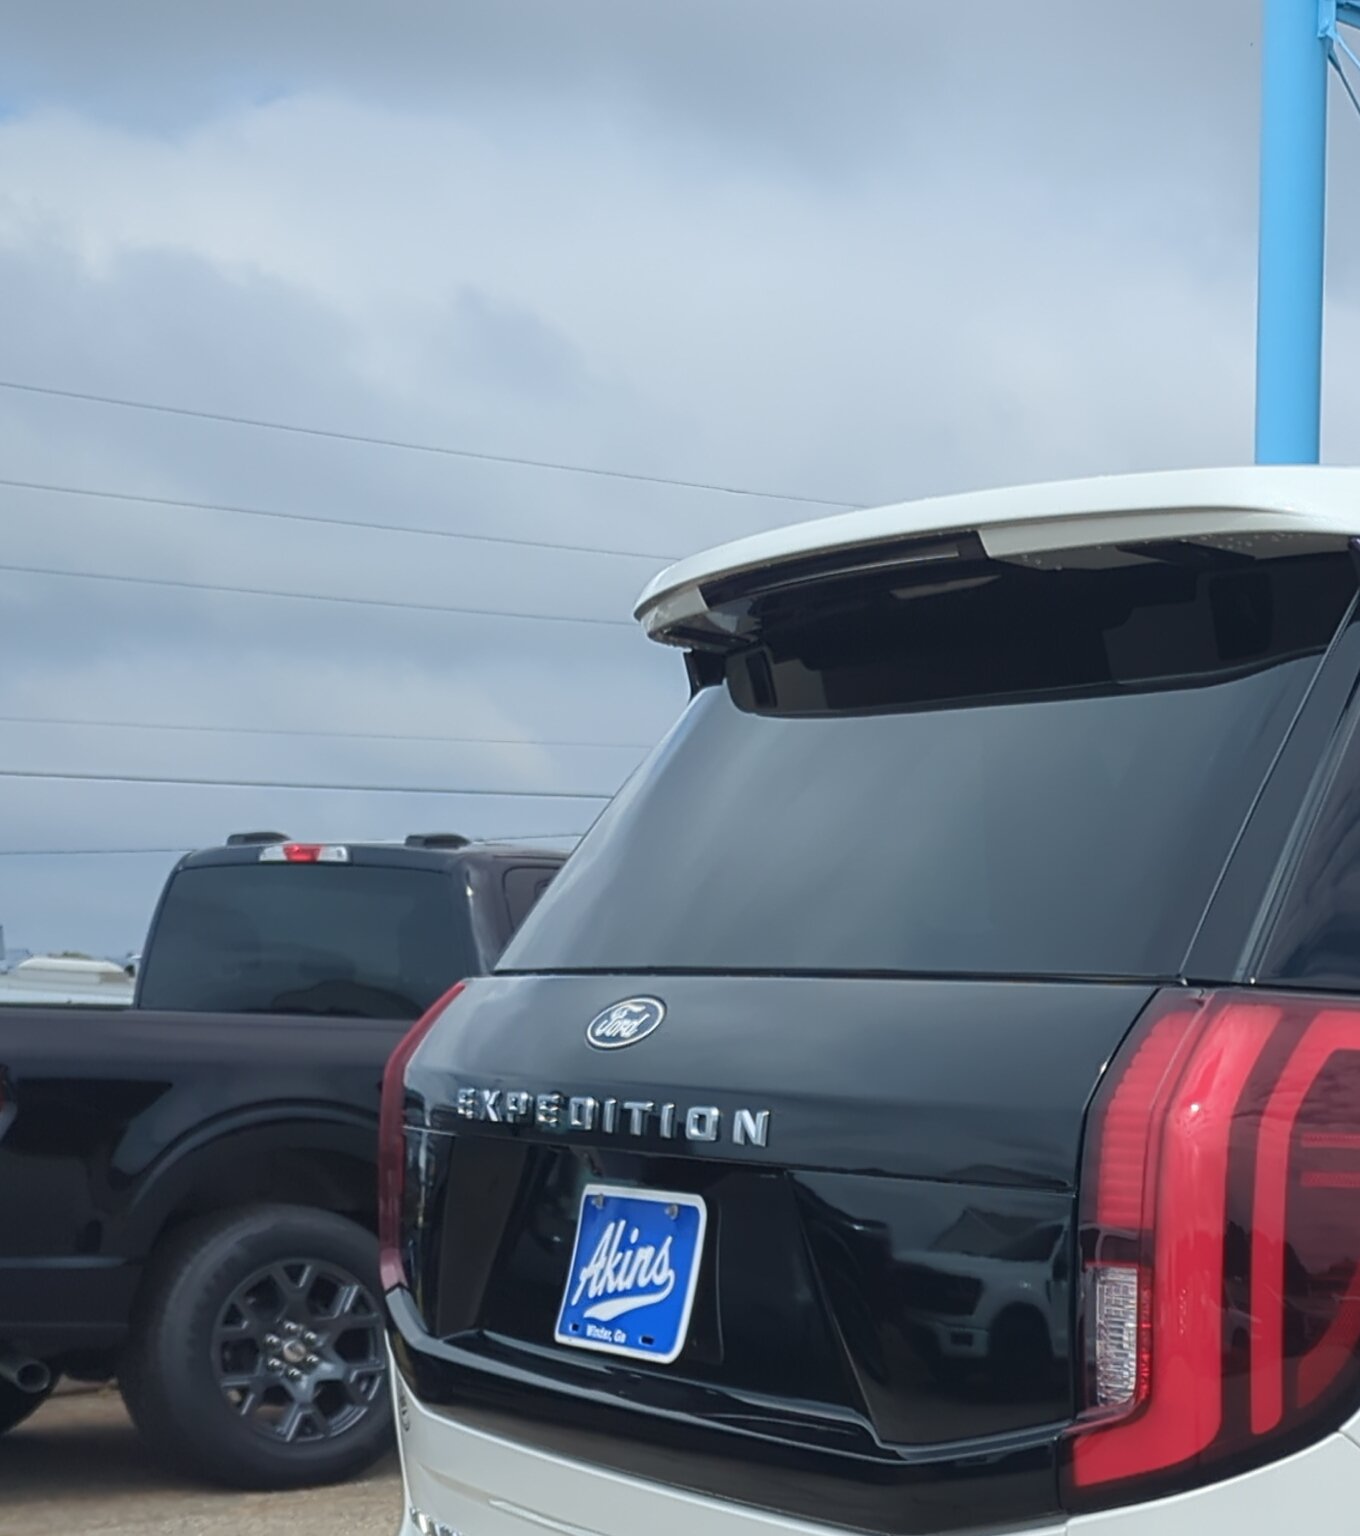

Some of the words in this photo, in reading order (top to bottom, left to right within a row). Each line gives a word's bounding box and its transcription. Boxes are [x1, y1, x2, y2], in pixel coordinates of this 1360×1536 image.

[595, 1004, 650, 1038] Ford
[457, 1087, 770, 1147] EXPEDITION
[572, 1219, 674, 1306] Akins
